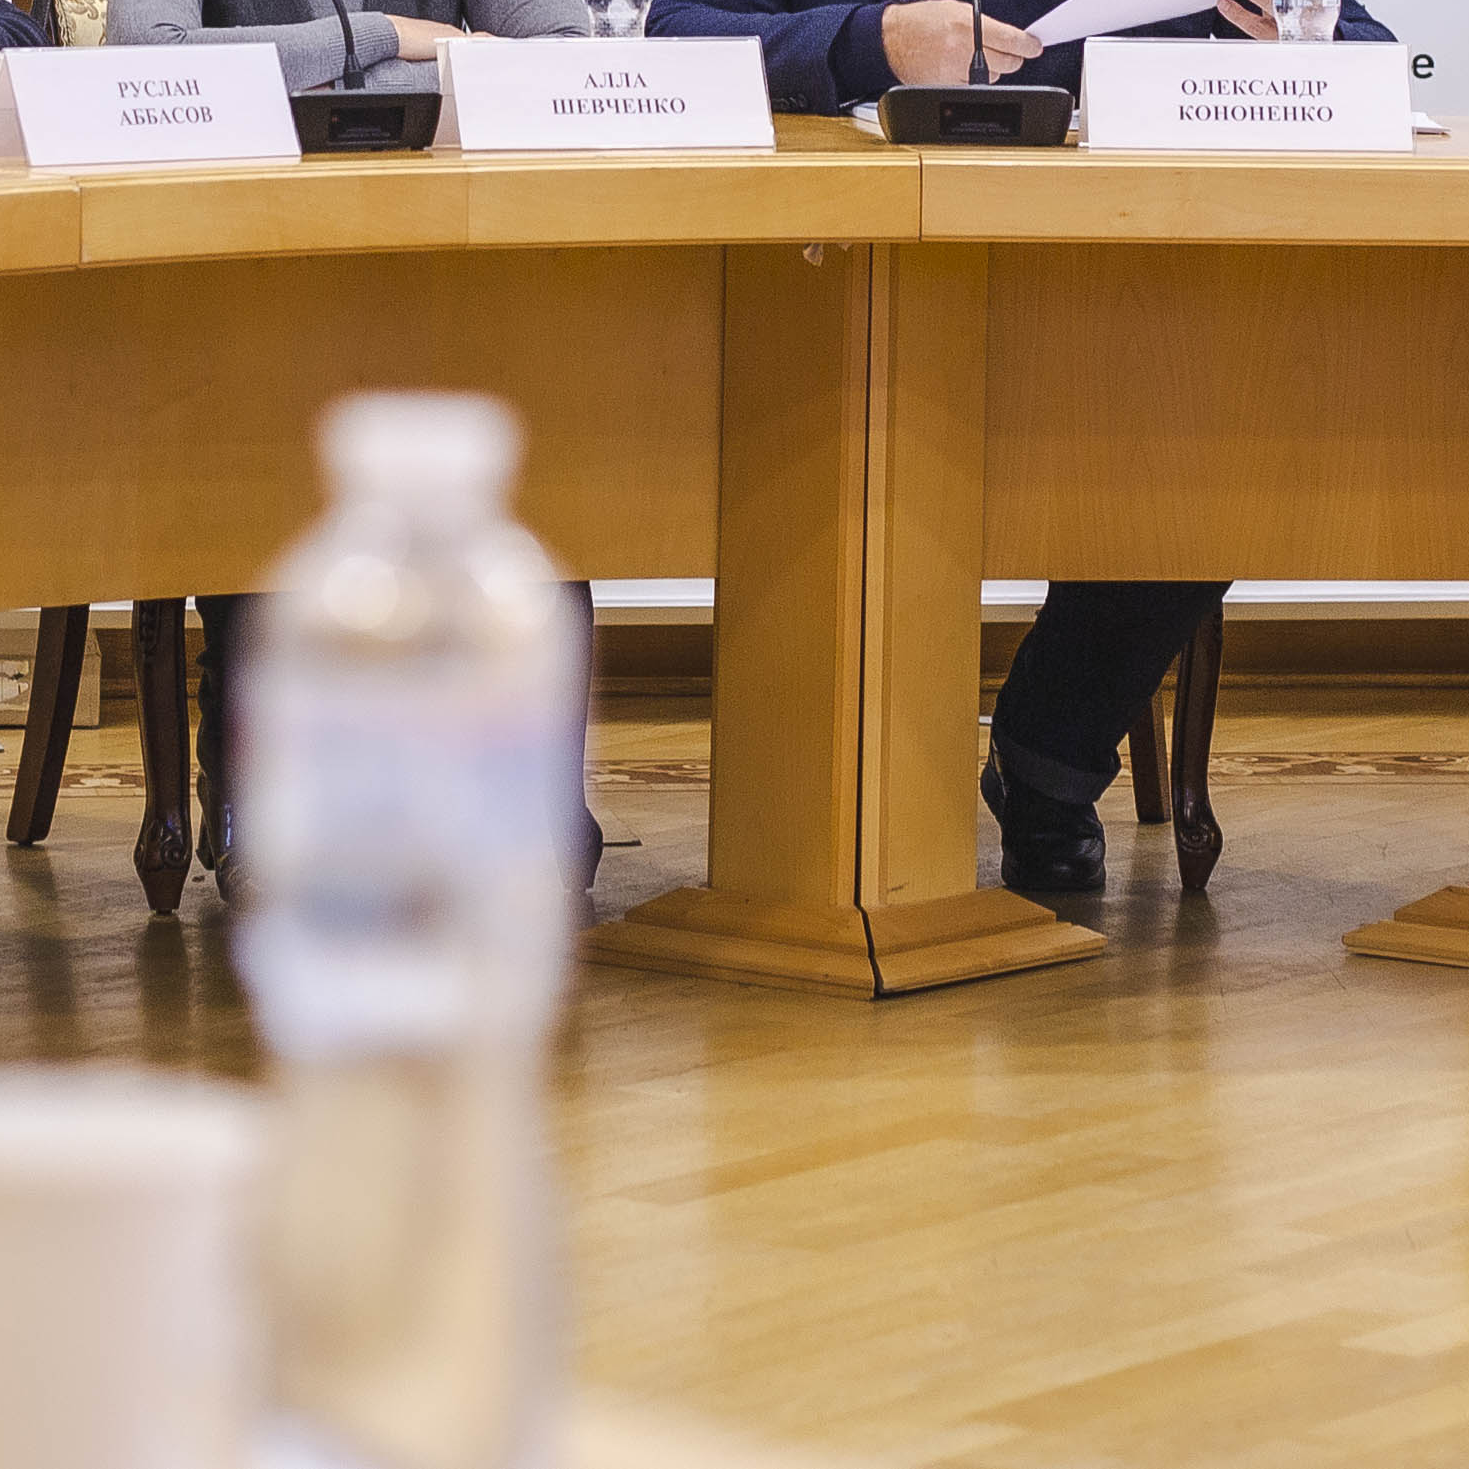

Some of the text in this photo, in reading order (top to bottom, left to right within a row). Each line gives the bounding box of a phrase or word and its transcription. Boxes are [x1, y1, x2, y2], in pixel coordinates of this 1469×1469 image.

[118, 79, 200, 99] РУСЛАН
[584, 72, 647, 89] АЛЛА
[1181, 79, 1328, 99] ОЛЕКСАНДР
[552, 97, 686, 115] ШЕВЧЕНКО
[1179, 104, 1334, 122] КОНОНЕНКО
[120, 106, 213, 126] АББАСОВ
